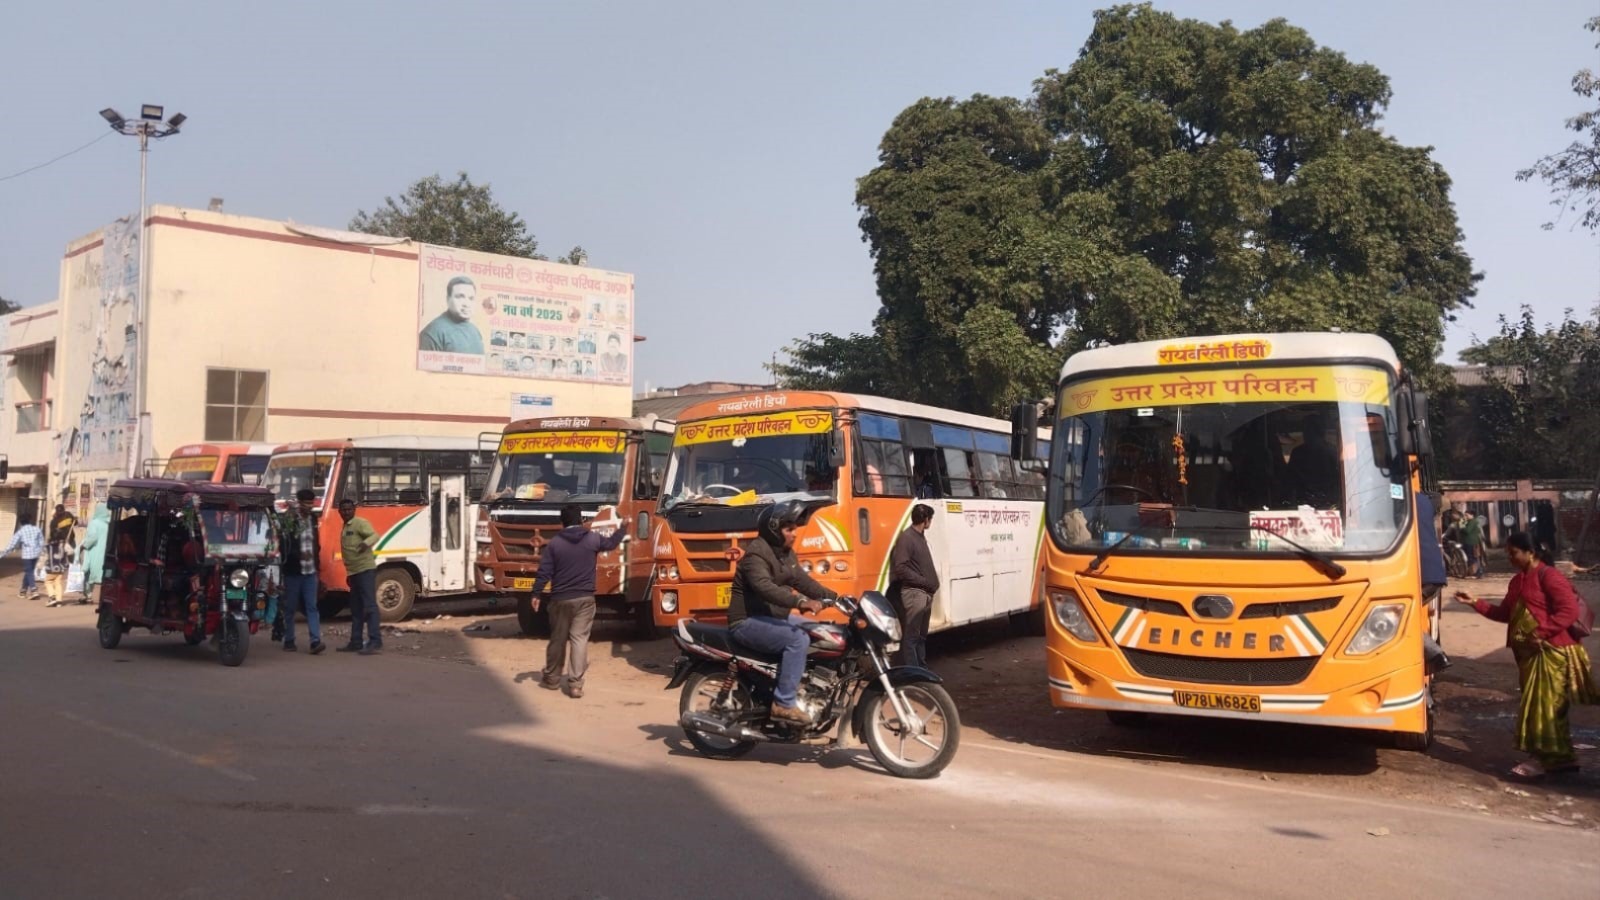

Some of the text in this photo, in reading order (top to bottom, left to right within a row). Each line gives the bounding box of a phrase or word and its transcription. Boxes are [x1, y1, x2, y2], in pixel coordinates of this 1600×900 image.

[426, 252, 466, 273] रोडवेज
[470, 260, 514, 279] कर्मचारी
[534, 268, 568, 290] संयुक्त
[503, 304, 563, 321] नव वर्ष 2025
[1232, 341, 1266, 360] डिपो
[1110, 373, 1318, 403] उत्तर प्रदेश परिवहन
[718, 394, 787, 412] रायबरेली डिपो
[707, 416, 792, 440] उत्तर प्रदेश परिवहन
[520, 431, 600, 450] उत्तर प्रदेश परिवहन
[1148, 626, 1286, 653] EICHER
[1176, 690, 1259, 712] UP78LN6826
